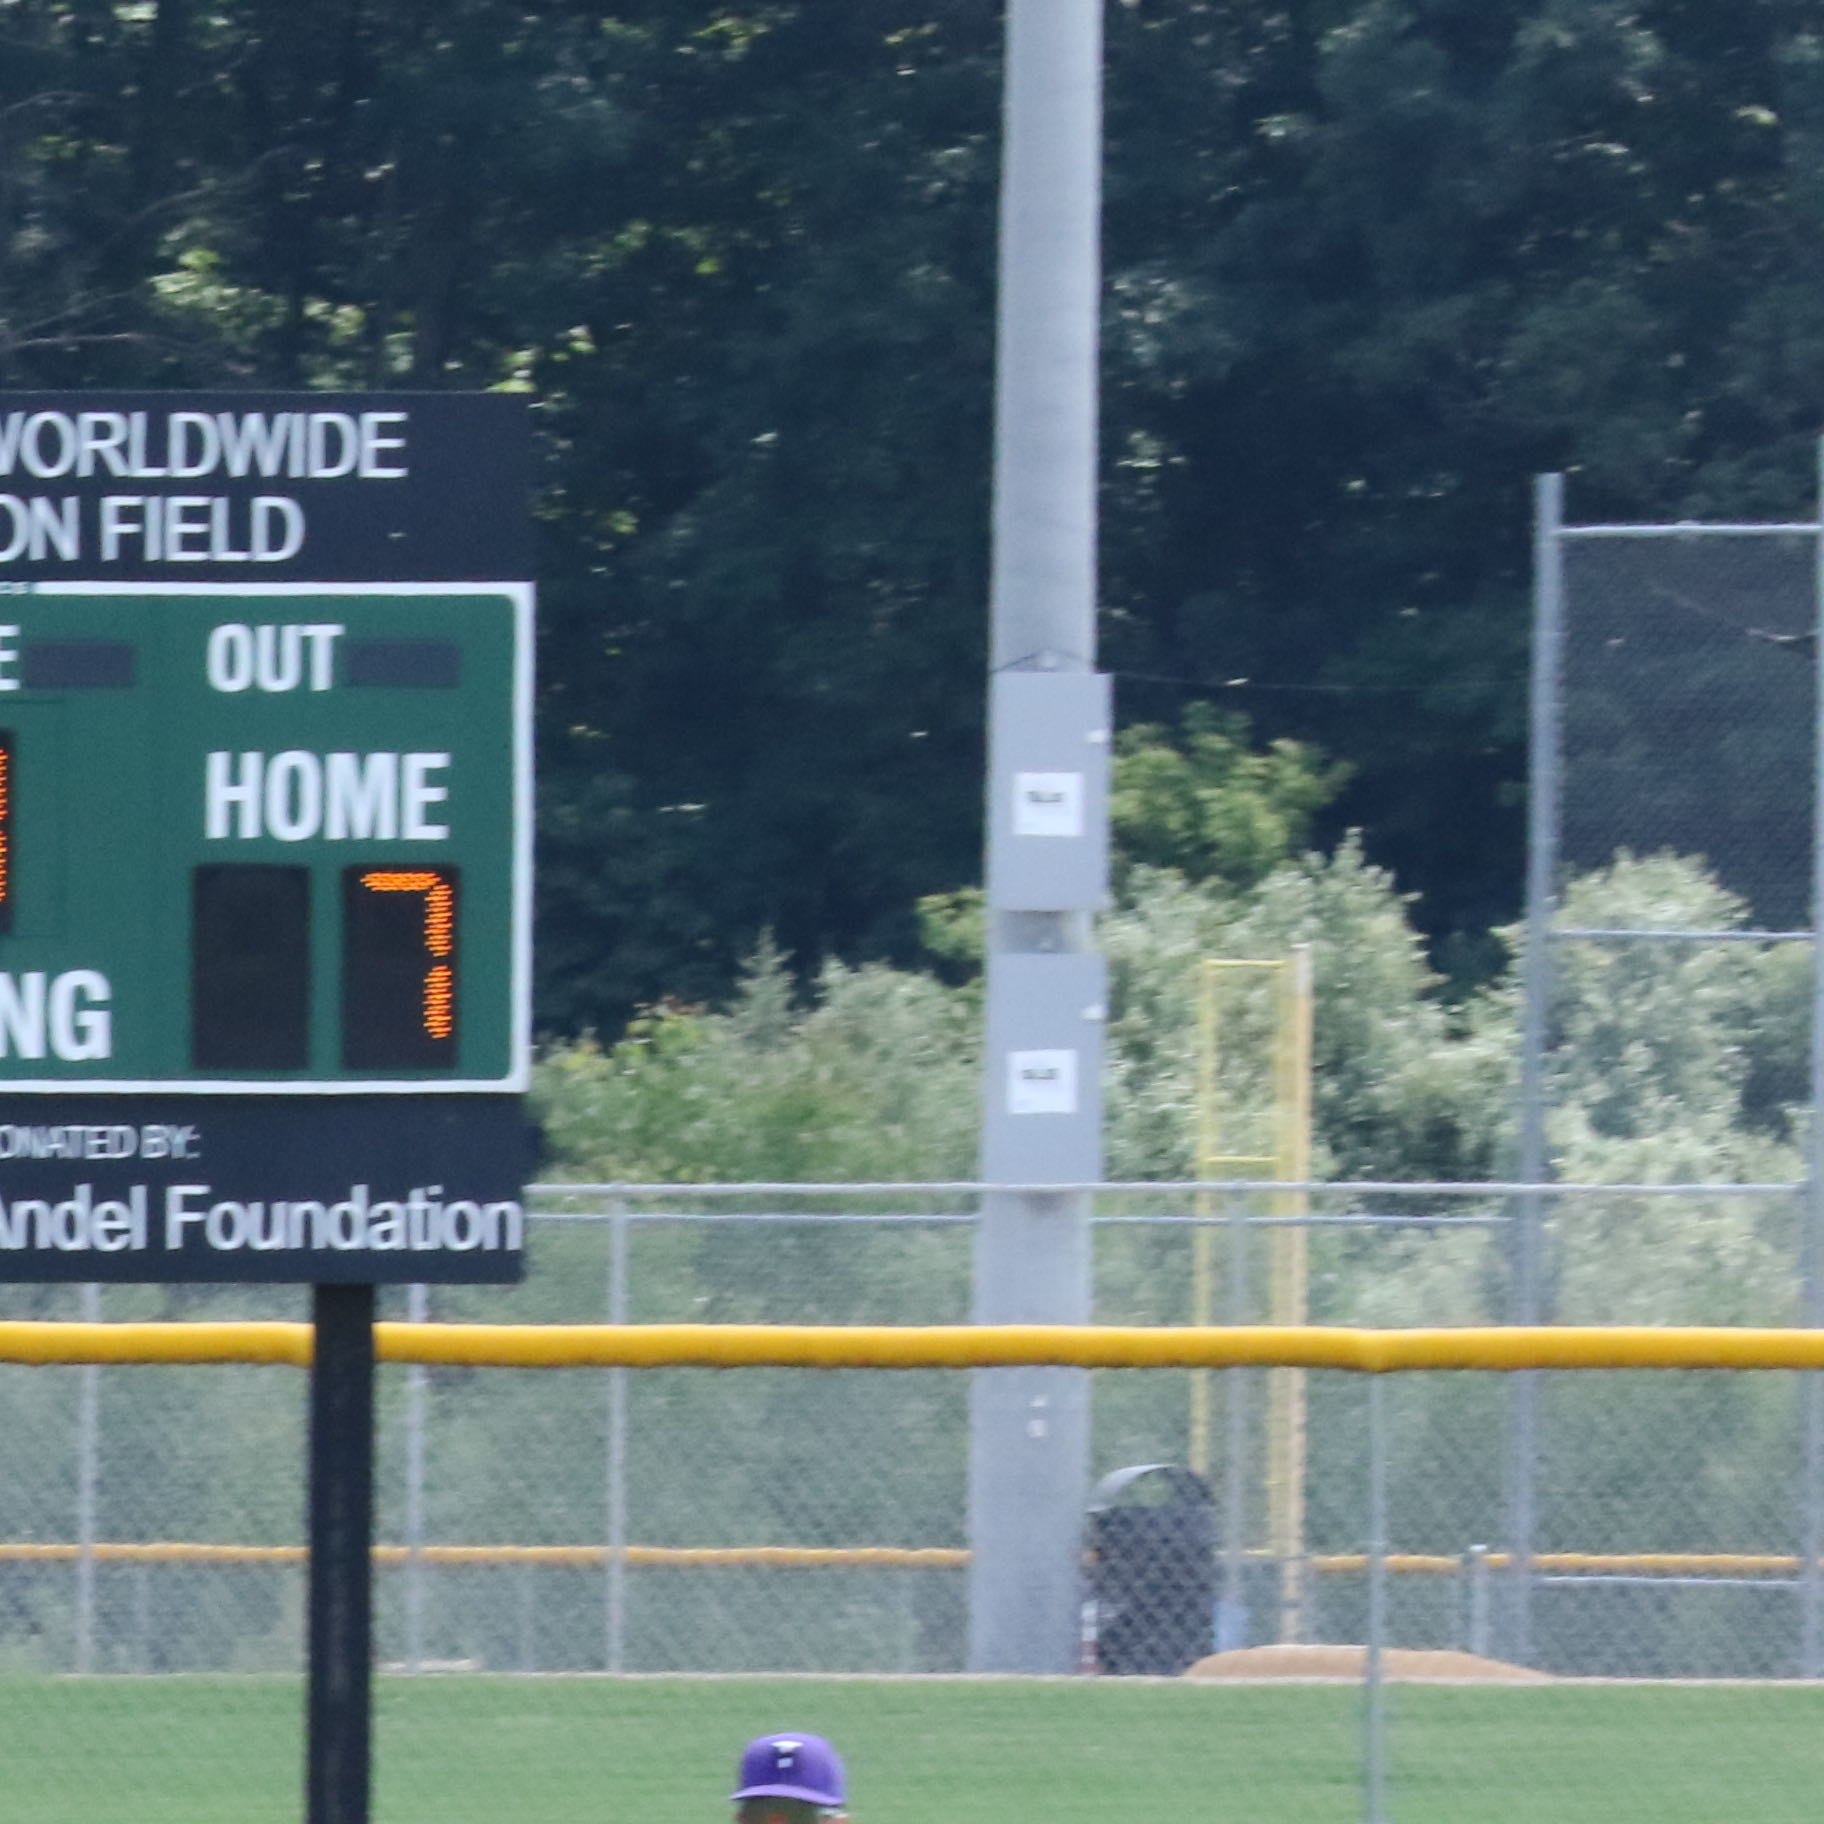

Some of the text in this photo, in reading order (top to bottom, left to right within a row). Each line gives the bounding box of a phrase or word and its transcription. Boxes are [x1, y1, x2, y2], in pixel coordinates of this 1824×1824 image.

[101, 496, 304, 561] FIELD
[208, 624, 344, 692] OUT
[206, 750, 450, 841] HOME
[363, 872, 452, 1038] 7
[142, 1125, 199, 1158] BY:
[166, 1184, 522, 1250] Foundation
